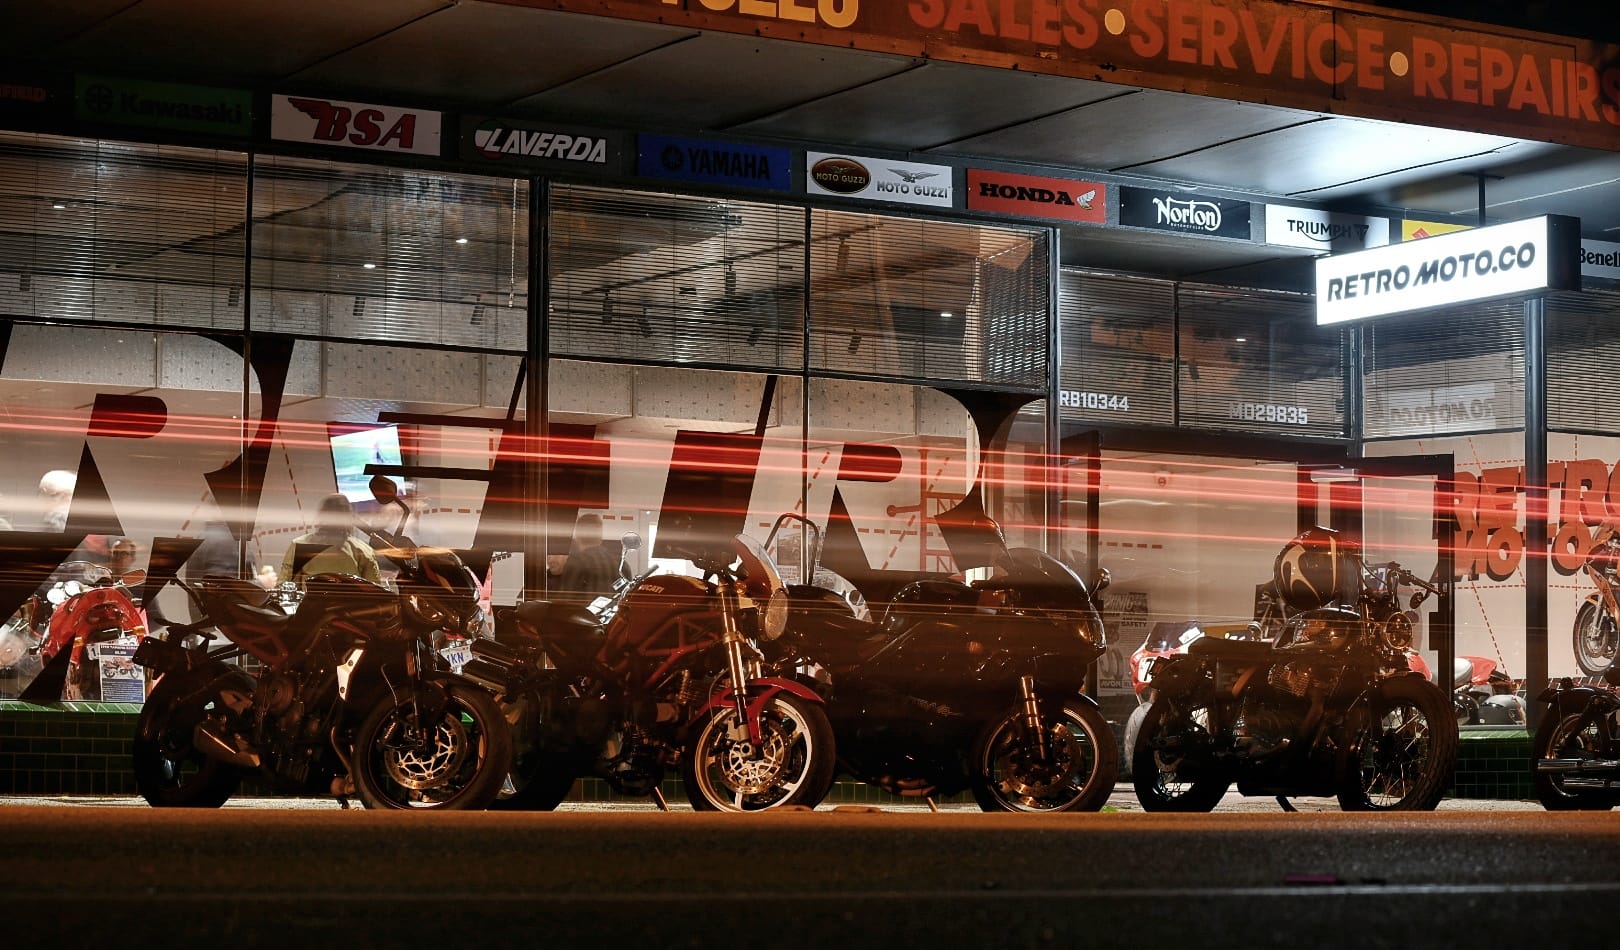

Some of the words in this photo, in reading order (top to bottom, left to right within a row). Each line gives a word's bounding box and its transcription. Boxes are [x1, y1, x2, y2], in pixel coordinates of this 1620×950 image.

[1129, 0, 1385, 91] SERVICE
[121, 92, 241, 125] Kawasaki
[312, 104, 416, 149] BSA
[487, 128, 606, 163] LAVERDA
[688, 148, 771, 181] YAMAHA
[816, 172, 839, 182] MOTO
[841, 175, 866, 185] GUZZI
[877, 181, 910, 195] MOTO
[914, 185, 948, 198] GUZZI
[979, 182, 1075, 206] HONDA
[1153, 196, 1222, 231] Norton
[1287, 219, 1348, 241] TRIUMPH
[1328, 264, 1411, 302] RETRO
[1413, 241, 1536, 287] MOTO.CO
[1059, 390, 1130, 412] RB10344
